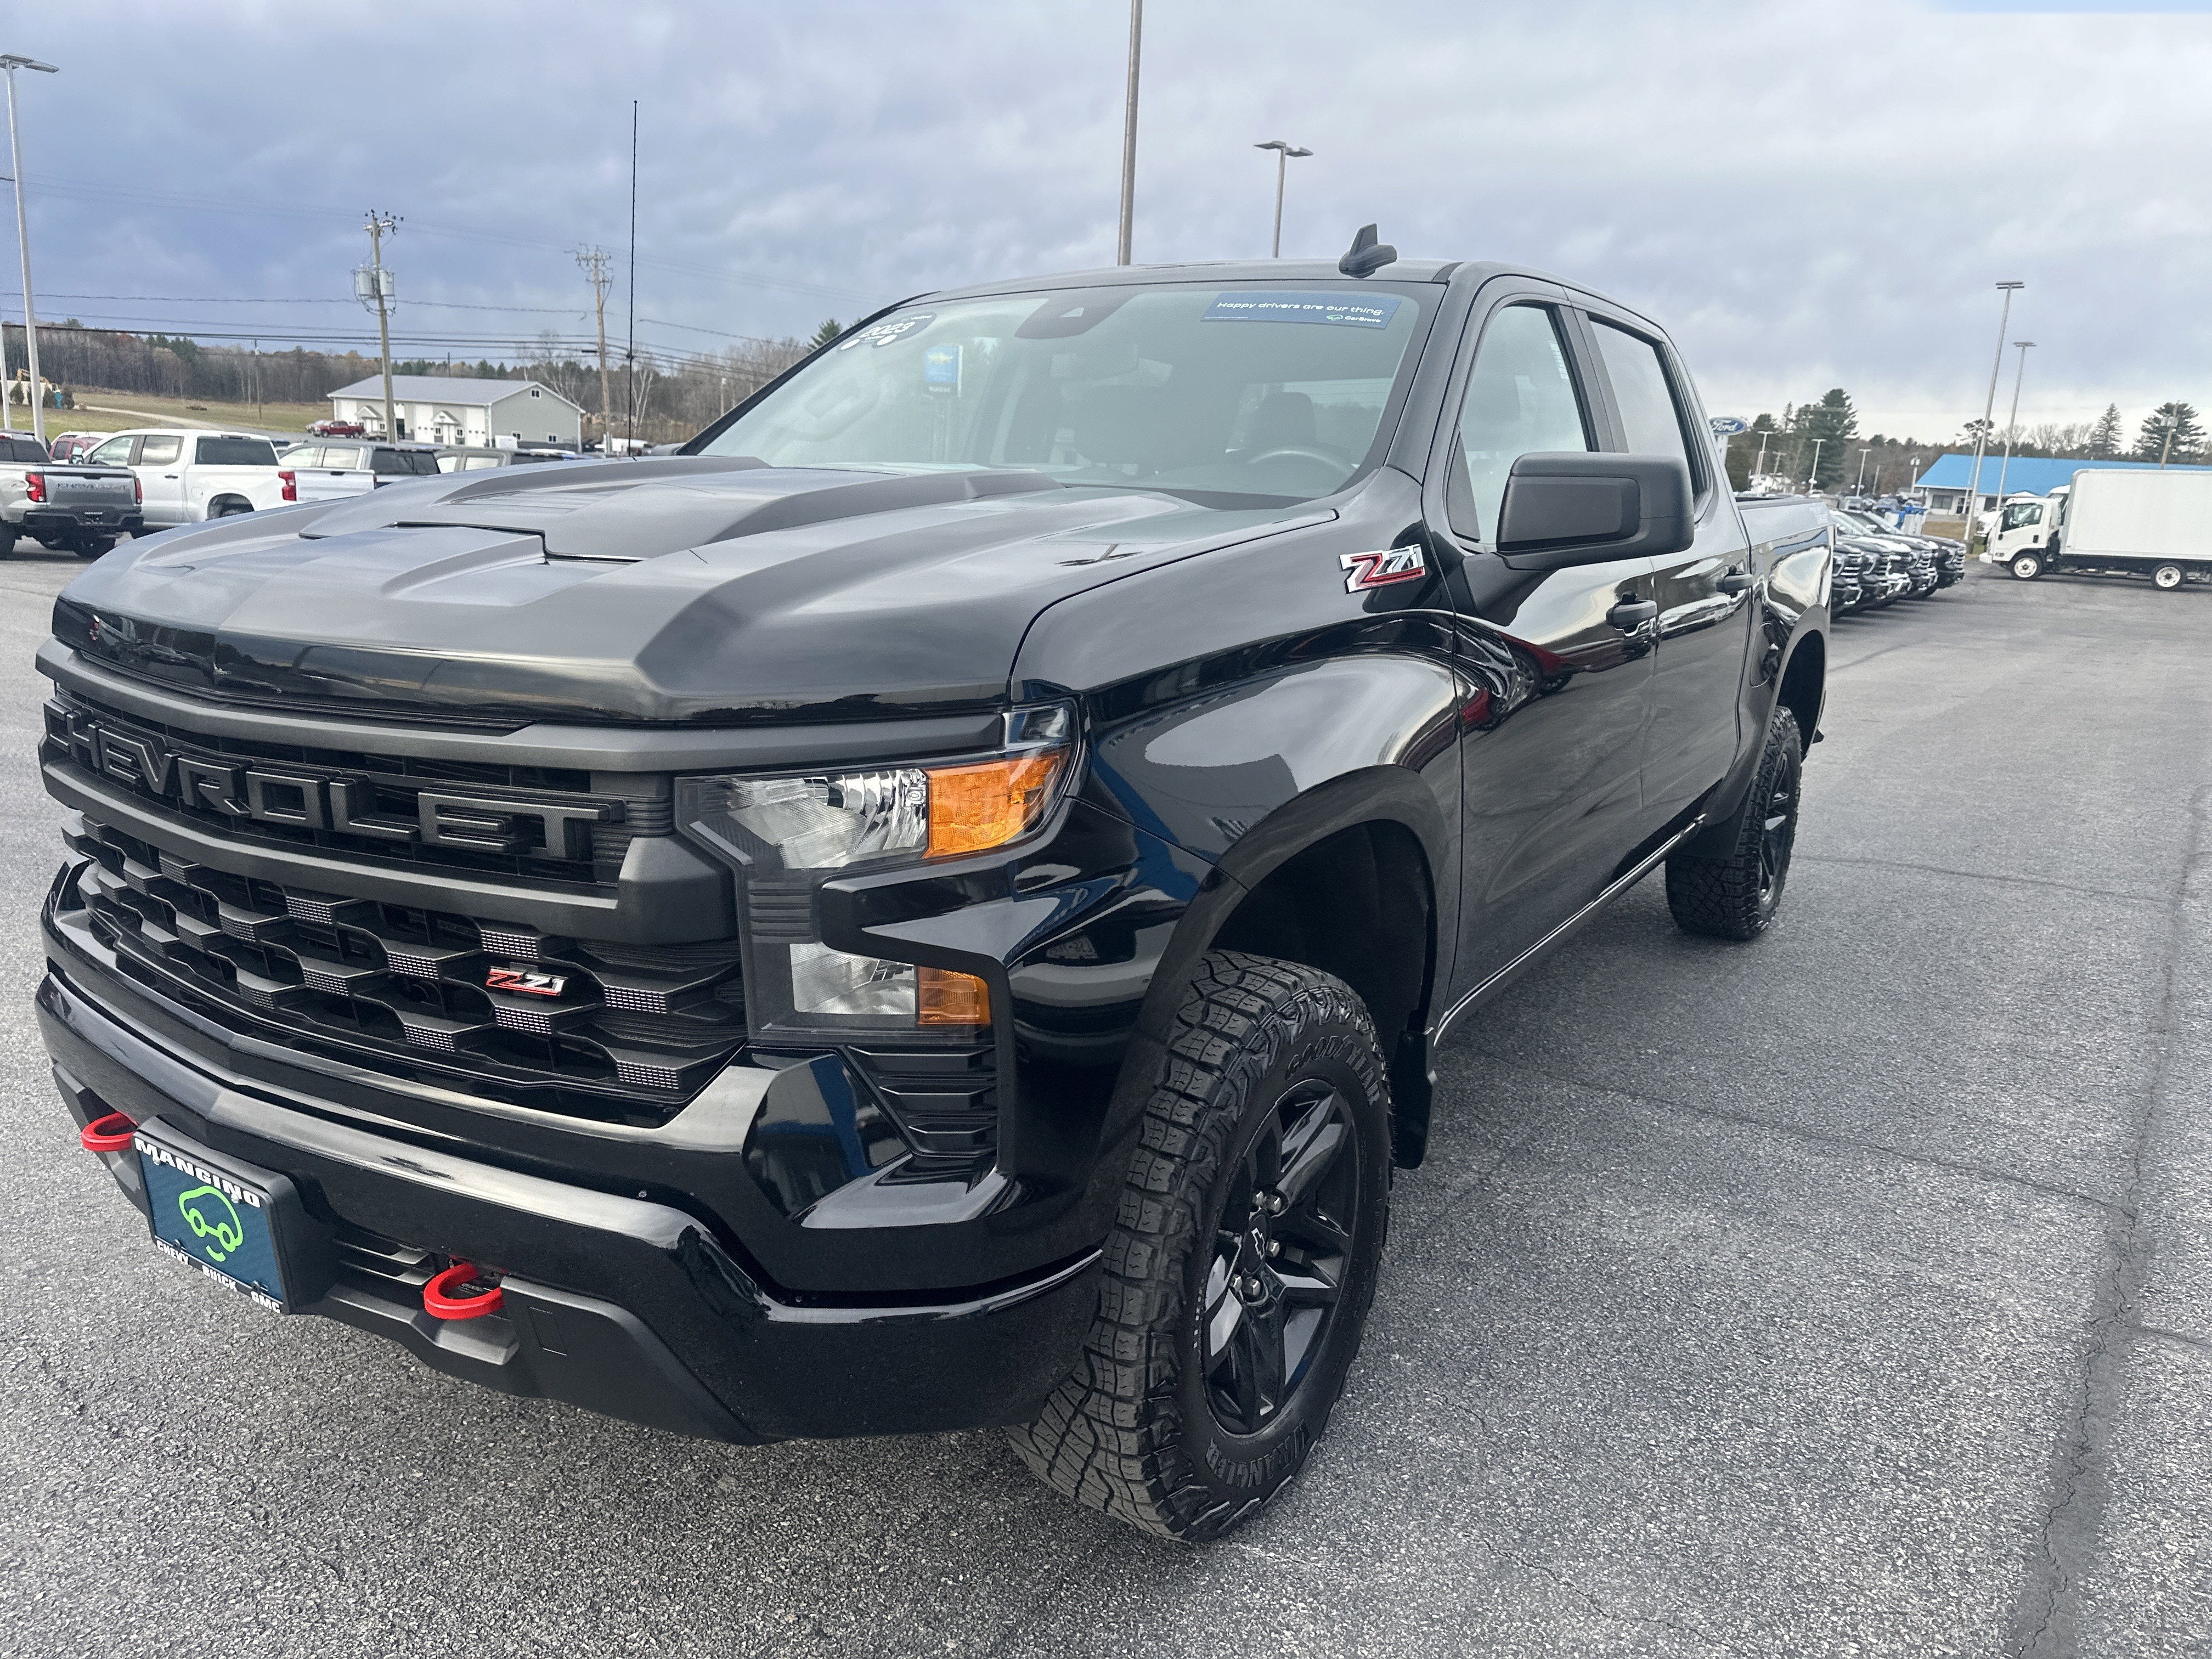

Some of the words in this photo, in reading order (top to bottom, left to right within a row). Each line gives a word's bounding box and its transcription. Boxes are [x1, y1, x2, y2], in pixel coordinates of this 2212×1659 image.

[859, 321, 916, 338] 2023
[1711, 420, 1738, 431] Ford
[1339, 543, 1425, 593] Z71
[43, 695, 626, 860] CHEVROLET
[486, 968, 566, 996] Z71
[1285, 1035, 1380, 1107] GOODYEAR
[134, 1137, 261, 1208] MANGINO
[156, 1240, 189, 1265] CHEVY
[202, 1265, 238, 1291] BUICK
[251, 1291, 281, 1313] GMC
[1206, 1419, 1311, 1487] WRANGLER
